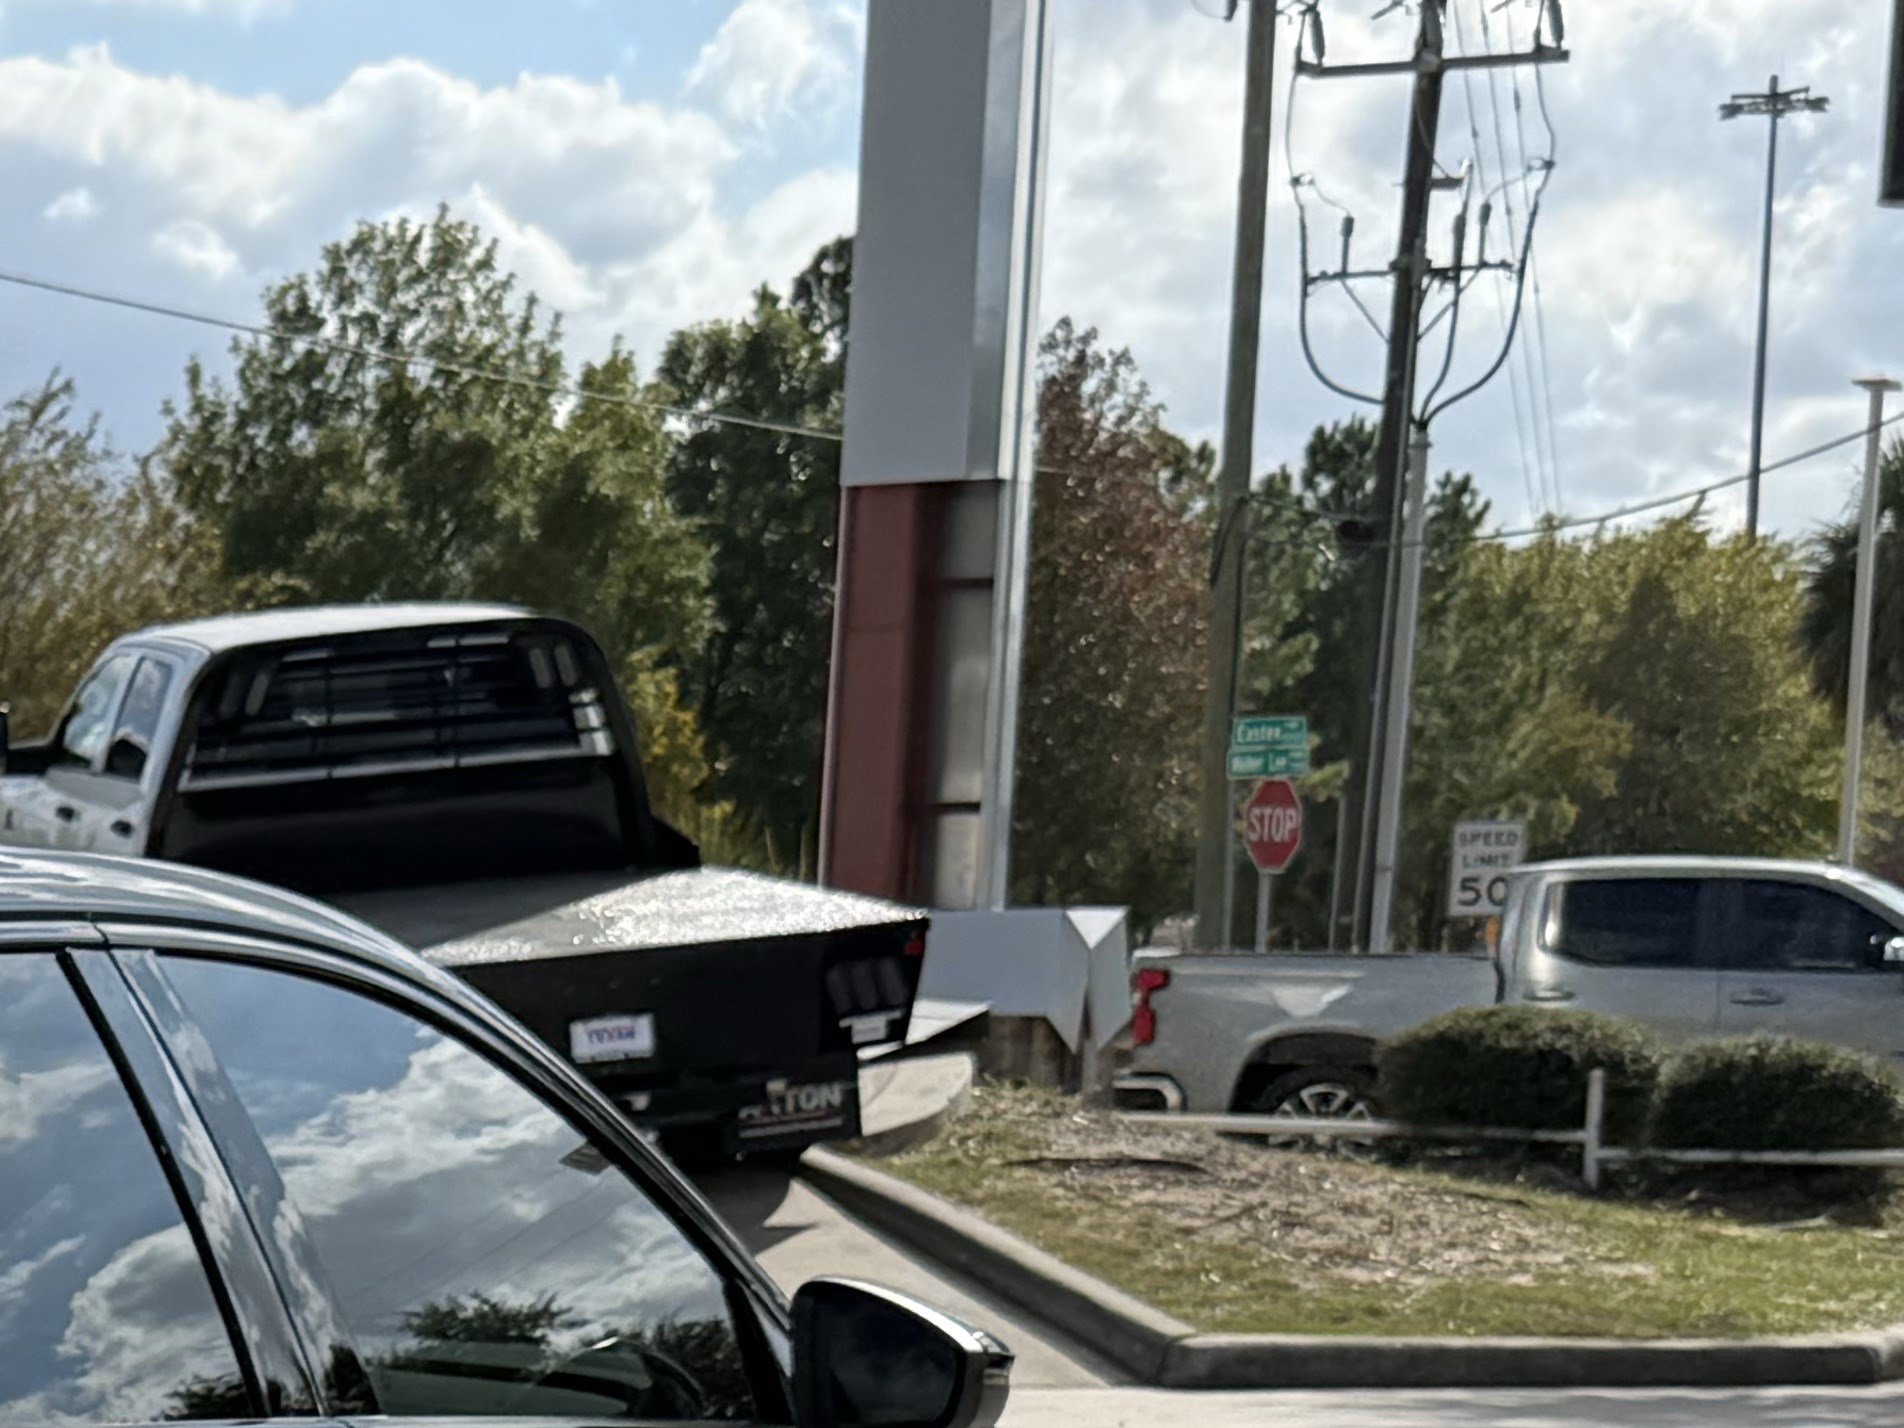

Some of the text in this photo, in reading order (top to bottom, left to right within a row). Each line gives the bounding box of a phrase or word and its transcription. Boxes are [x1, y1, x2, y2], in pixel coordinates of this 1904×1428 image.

[1247, 806, 1299, 842] STOP
[1458, 830, 1519, 847] SPEED
[1462, 852, 1510, 869] LIMIT
[1458, 876, 1509, 907] 50
